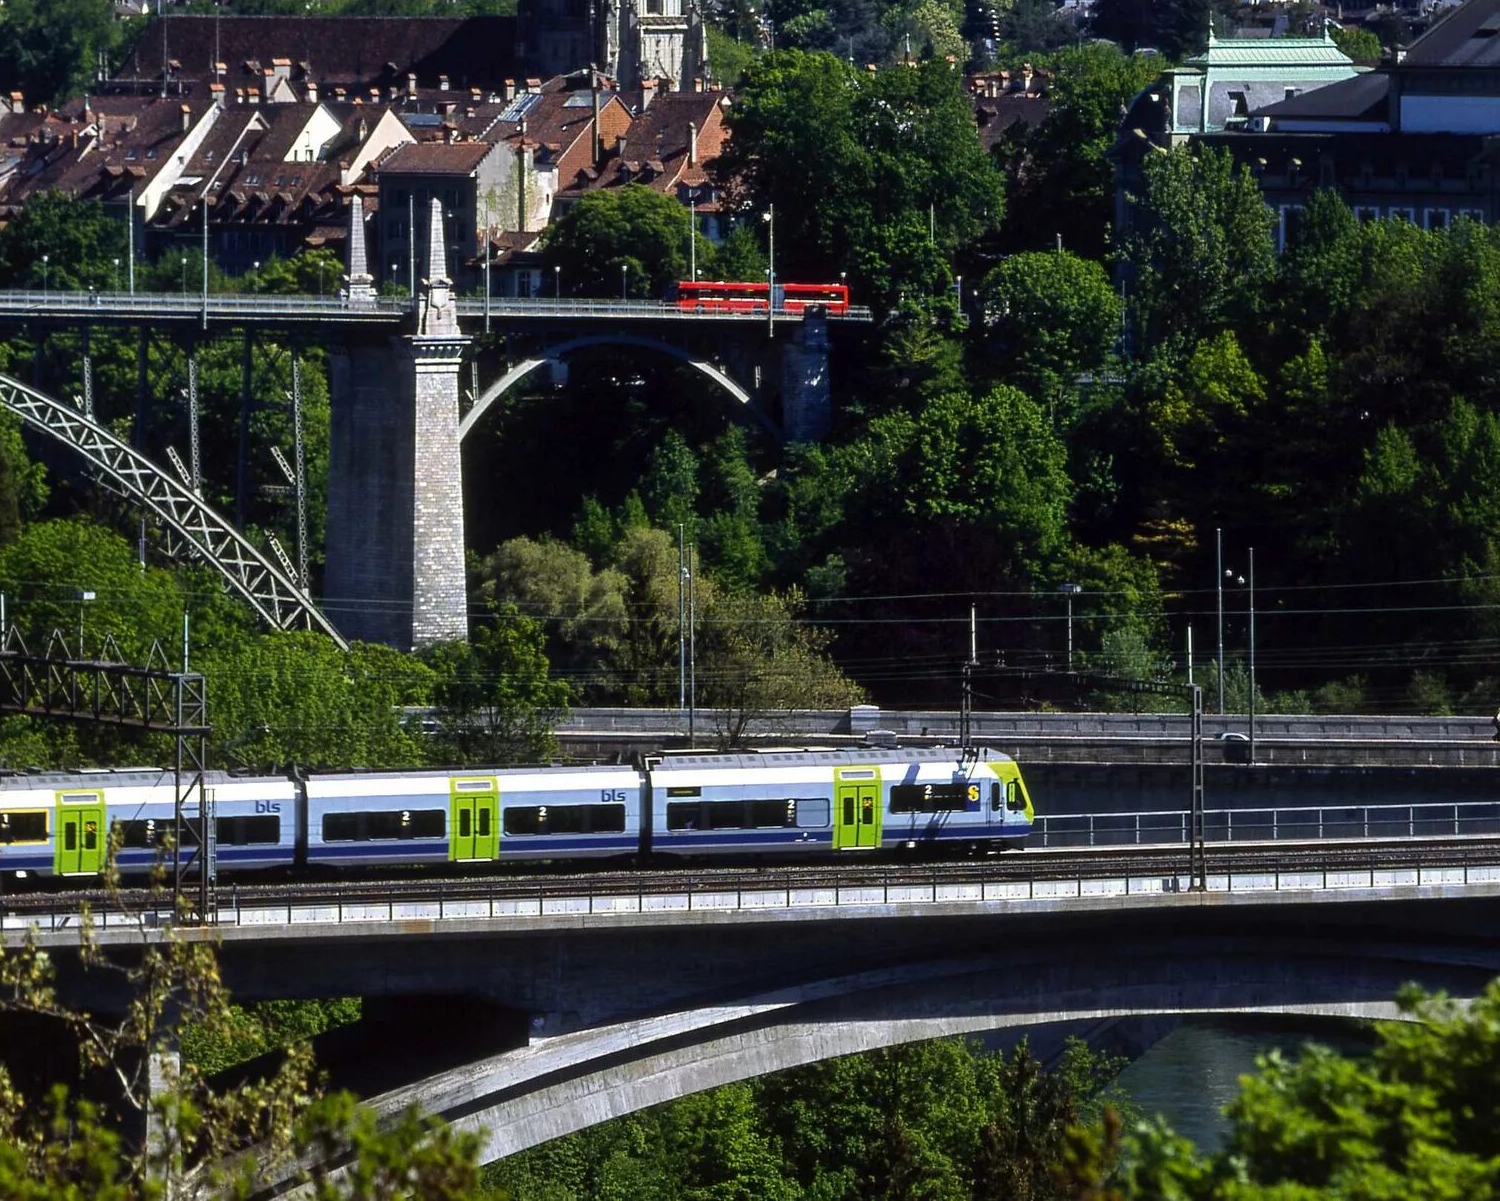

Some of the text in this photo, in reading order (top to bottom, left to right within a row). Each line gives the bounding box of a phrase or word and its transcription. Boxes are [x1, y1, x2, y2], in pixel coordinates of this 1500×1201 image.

[924, 785, 932, 794] 2
[968, 785, 979, 801] S
[601, 789, 625, 802] bls
[255, 800, 280, 813] bls
[787, 800, 795, 808] 2
[402, 811, 410, 820] 2
[539, 807, 547, 816] 2
